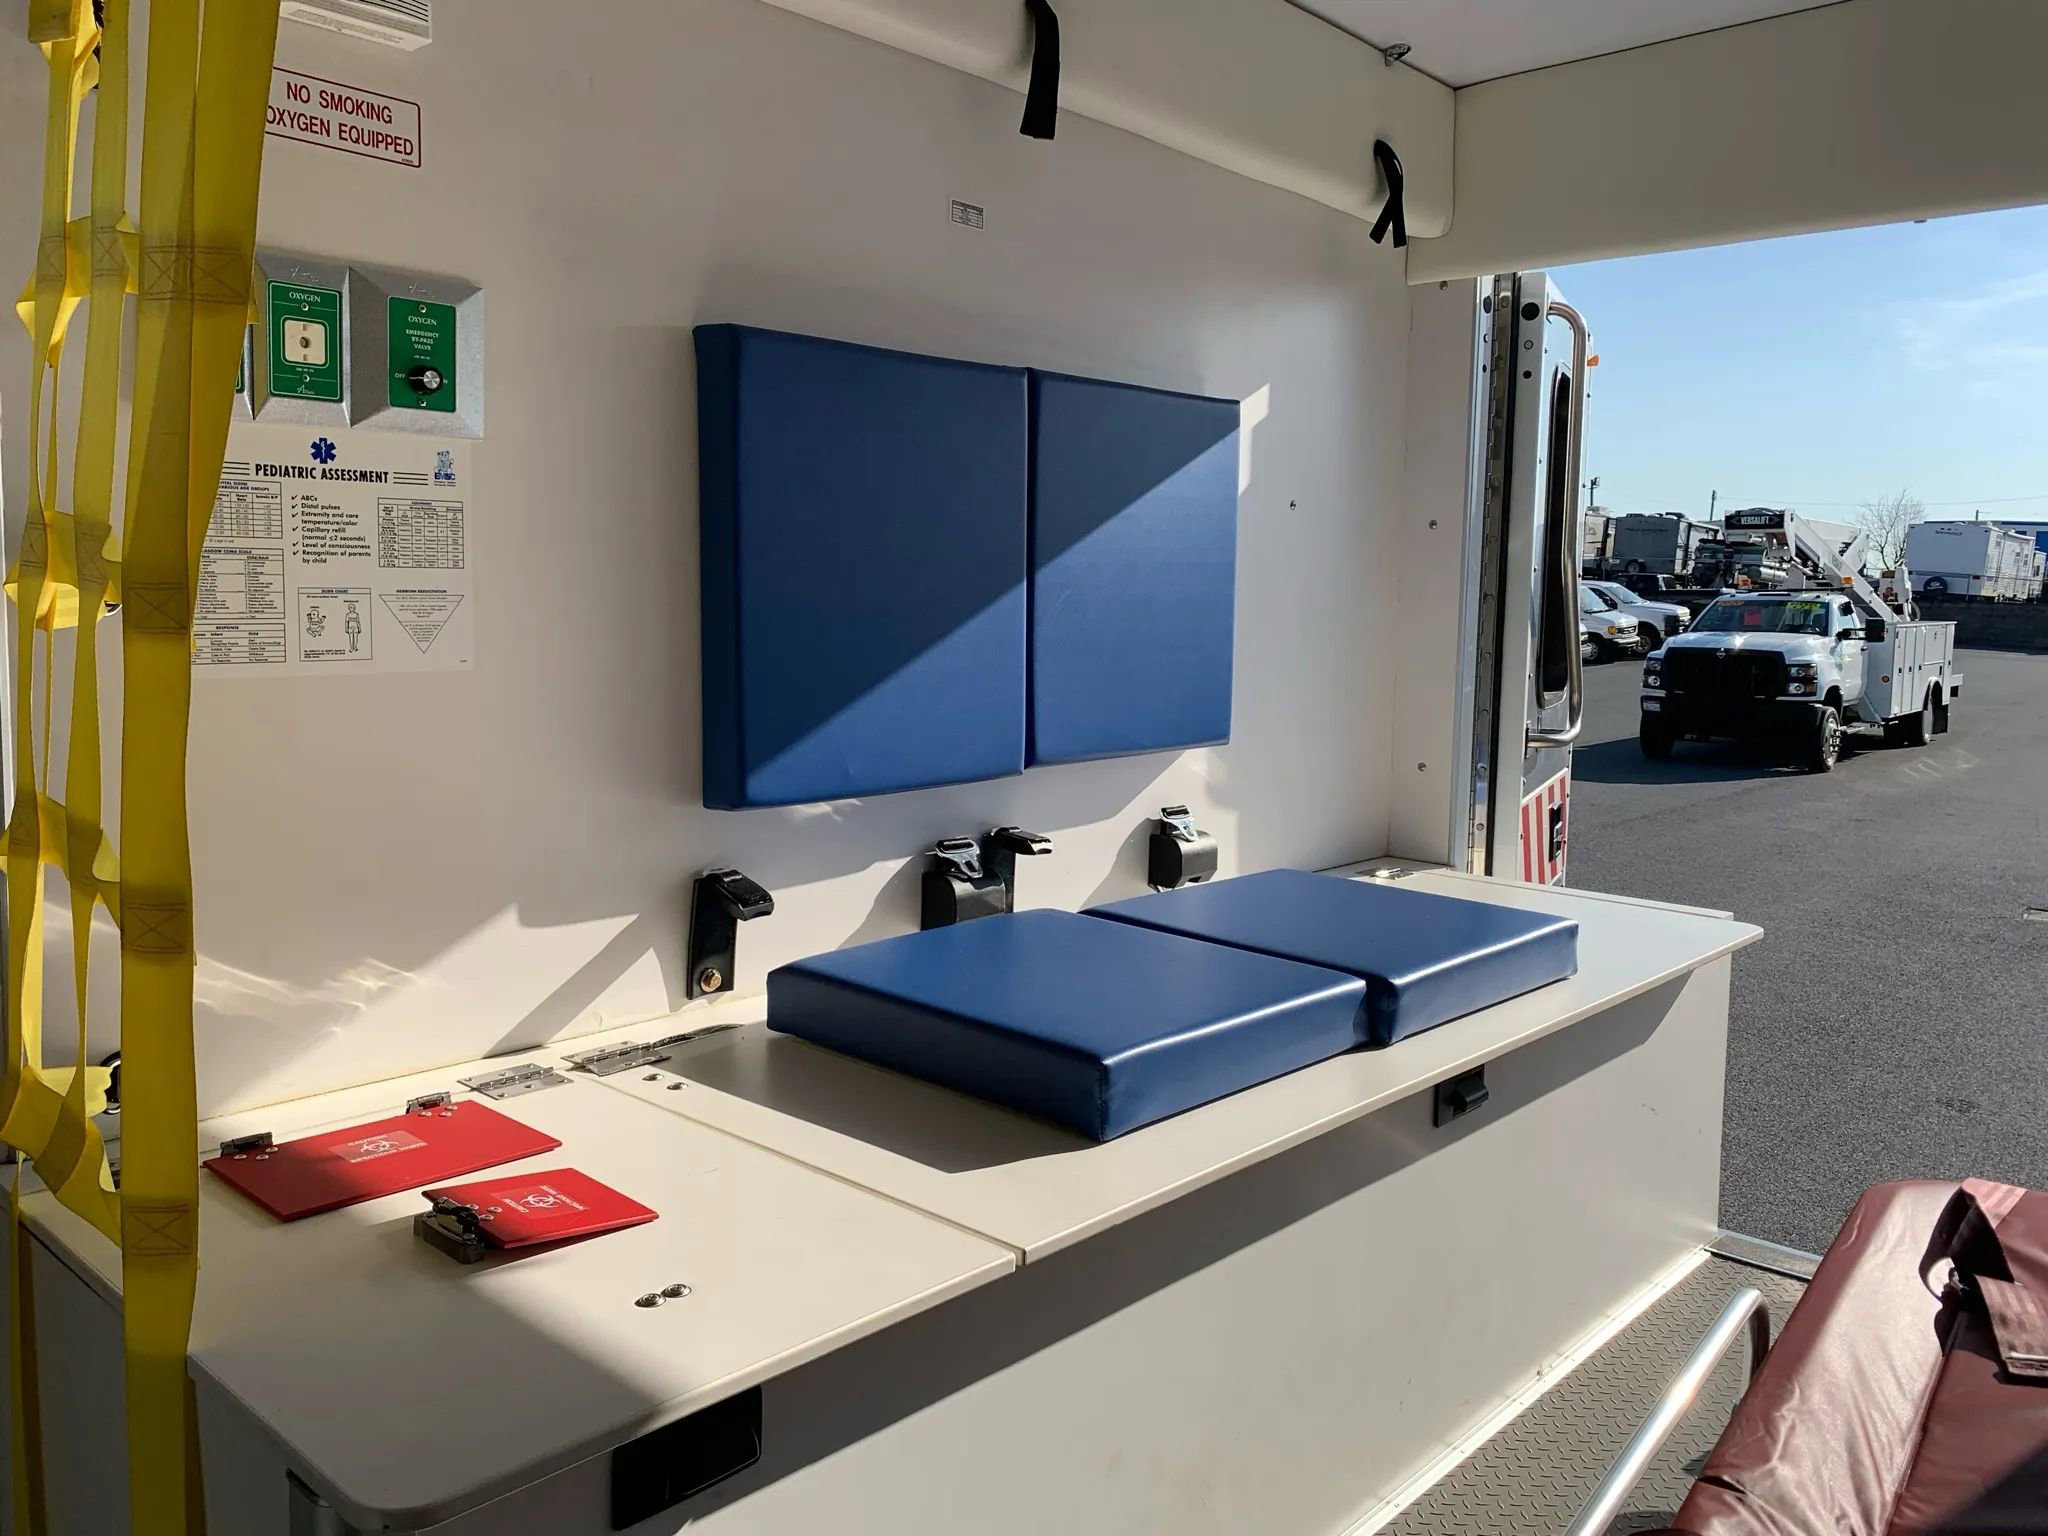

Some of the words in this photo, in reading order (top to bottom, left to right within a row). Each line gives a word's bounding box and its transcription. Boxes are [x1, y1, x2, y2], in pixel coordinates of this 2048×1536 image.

[287, 81, 311, 104] NO
[319, 89, 393, 125] SMOKING
[266, 105, 331, 138] OXYGEN
[339, 122, 414, 156] EQUIPPED
[289, 291, 321, 302] OXYGEN
[408, 315, 437, 326] OXYGEN
[405, 329, 439, 338] EMERGENCY
[411, 336, 434, 345] BY-PASS
[255, 463, 317, 480] PEDIATRIC
[320, 468, 389, 484] ASSESSMENT
[301, 511, 330, 519] Extremity
[1741, 516, 1769, 525] VERSALIFT
[301, 526, 331, 534] Capillary
